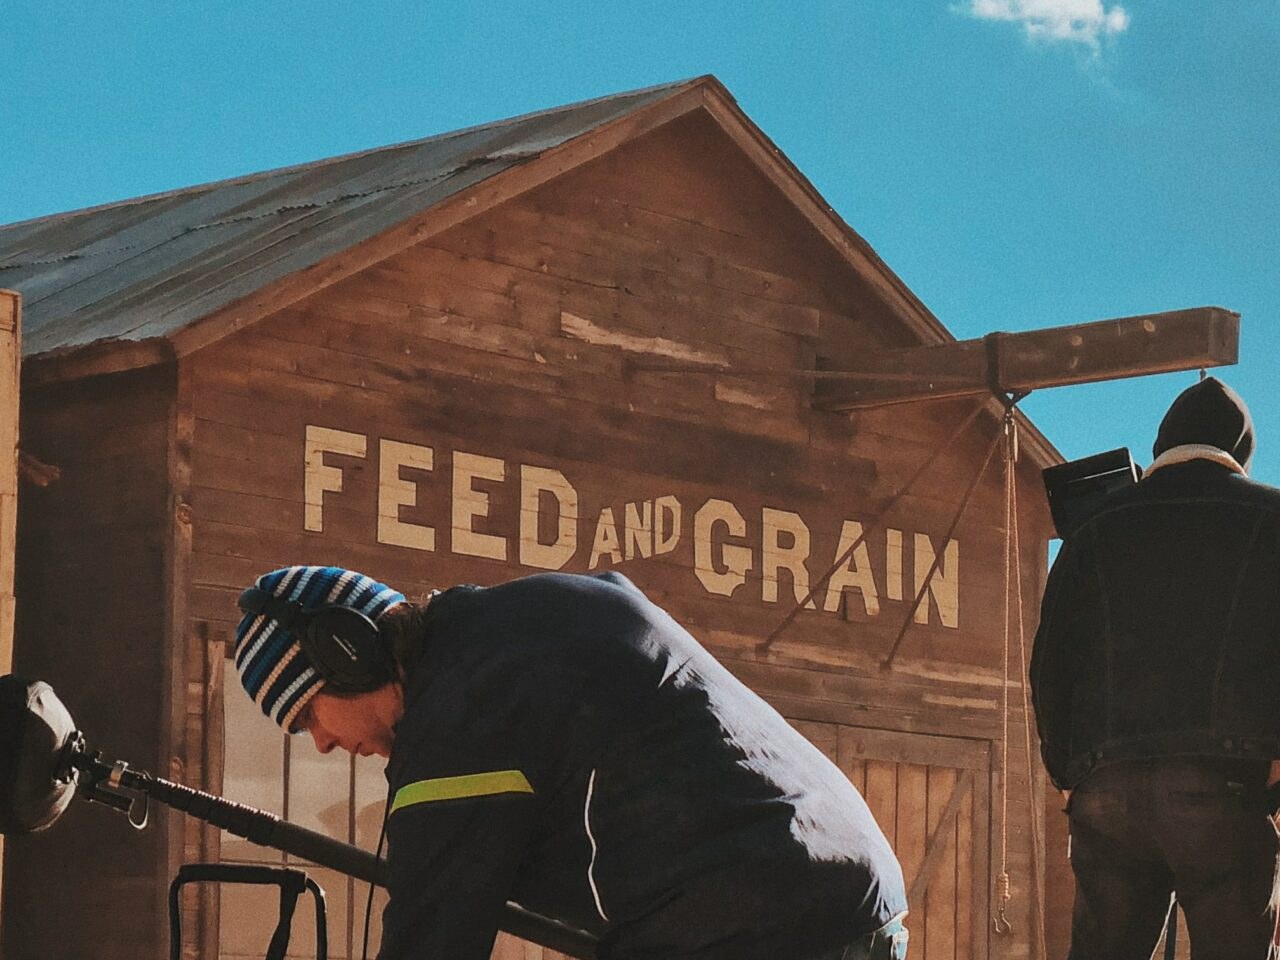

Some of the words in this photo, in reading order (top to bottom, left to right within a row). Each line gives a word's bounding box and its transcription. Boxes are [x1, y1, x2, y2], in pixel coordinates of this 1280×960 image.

[304, 425, 578, 571] FEED
[589, 494, 682, 570] AND
[693, 498, 960, 629] GRAIN
